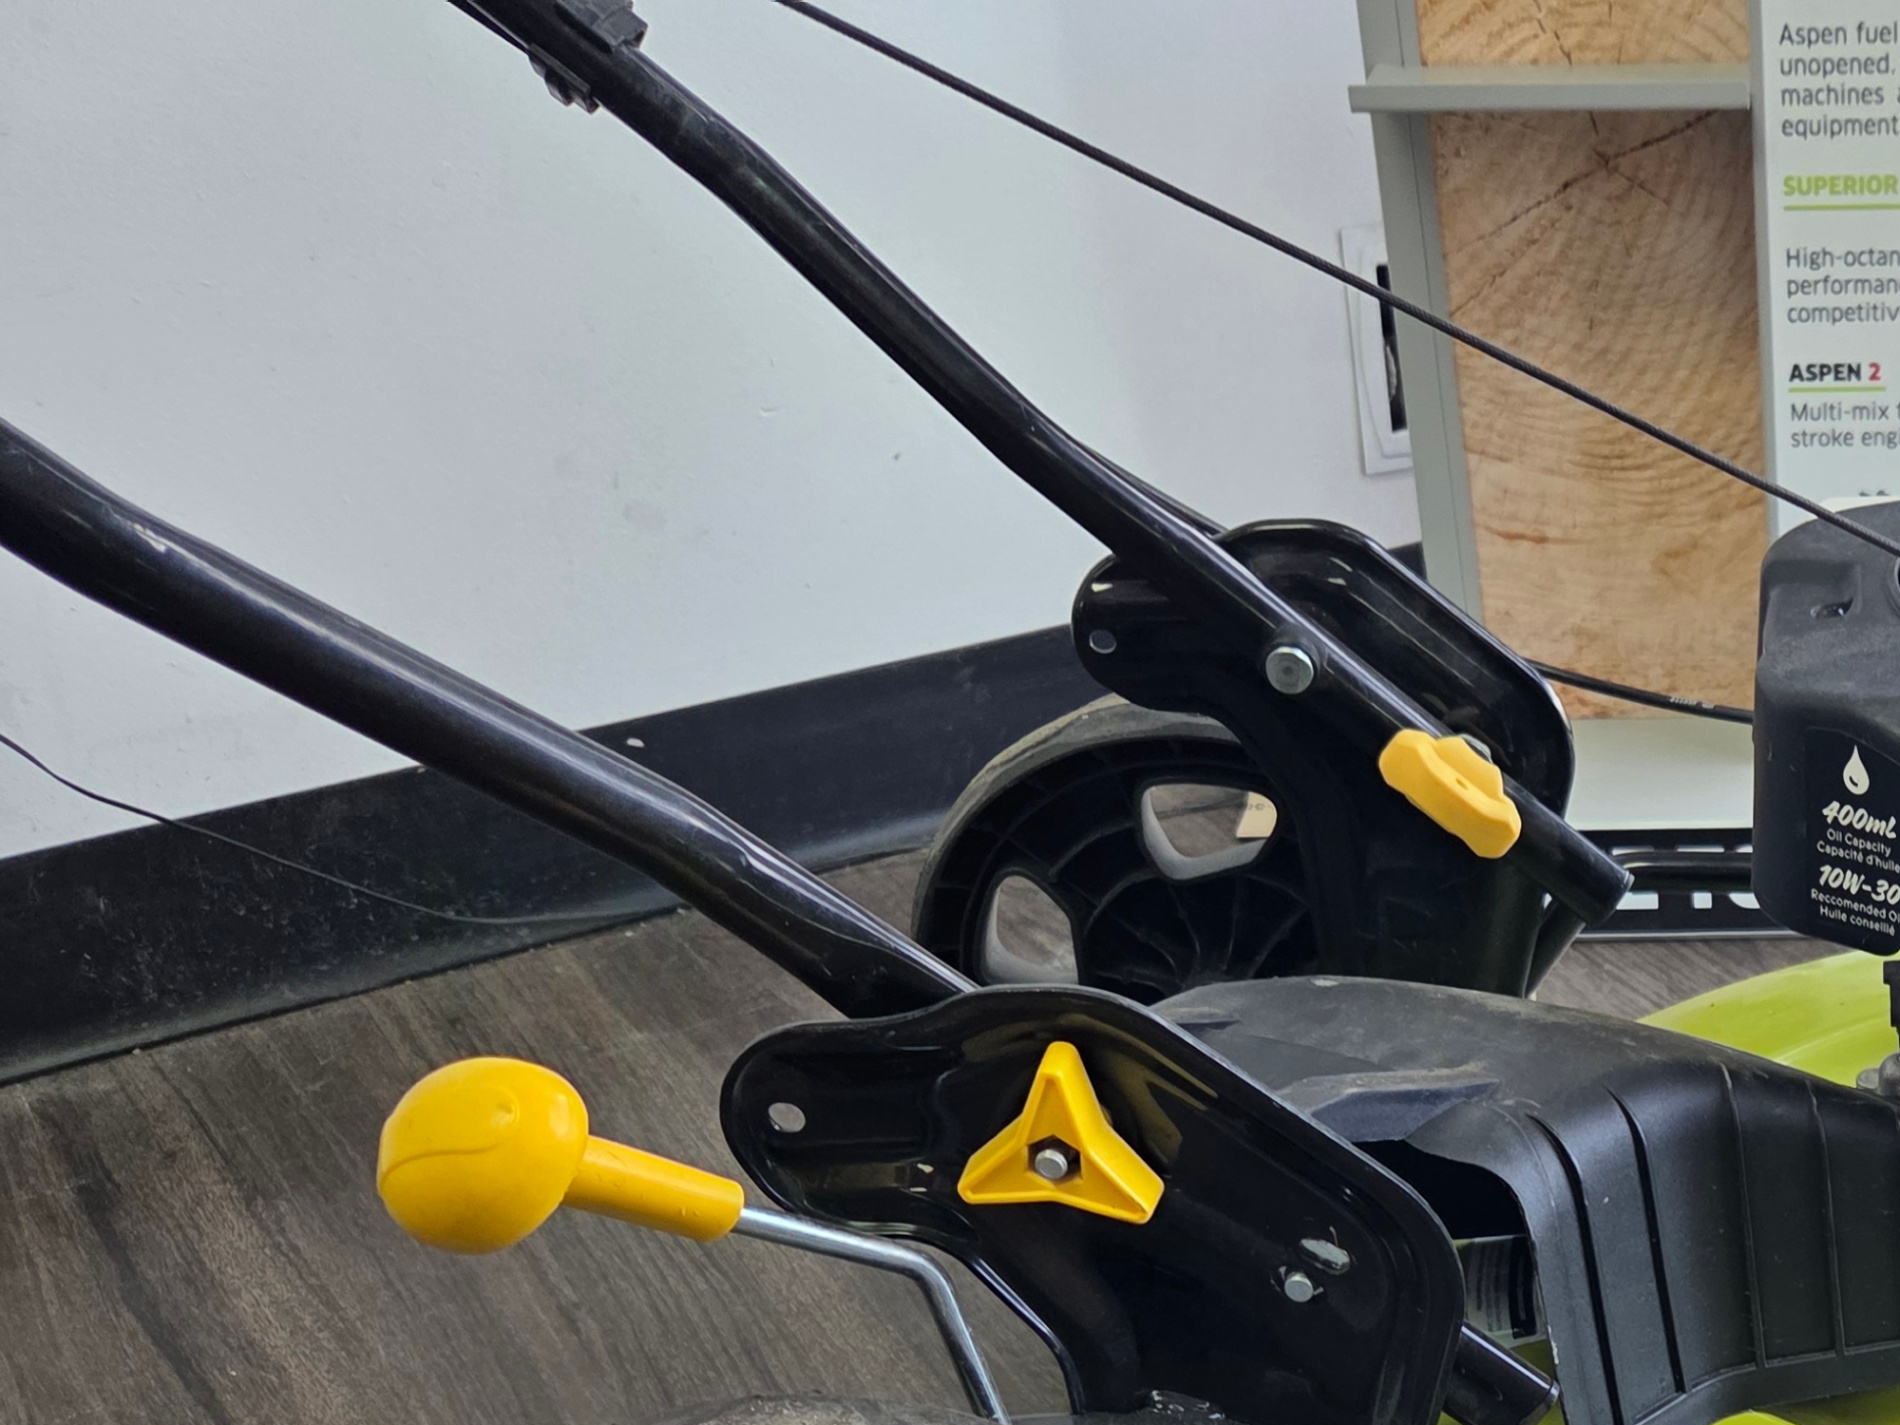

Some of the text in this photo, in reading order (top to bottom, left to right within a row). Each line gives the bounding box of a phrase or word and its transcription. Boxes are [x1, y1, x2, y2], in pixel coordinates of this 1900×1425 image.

[1779, 23, 1847, 49] Aspen
[1857, 21, 1898, 45] fuel
[1780, 53, 1896, 79] unopened.
[1781, 83, 1884, 106] machines
[1781, 114, 1899, 140] equipment
[1783, 174, 1898, 196] SUPERIOR
[1789, 363, 1881, 382] ASPEN 2
[1791, 402, 1889, 422] Multi-mix
[1791, 429, 1854, 448] stroke
[1822, 801, 1897, 838] 400mL
[1827, 828, 1891, 857] Oil Capacity
[1817, 840, 1900, 874] Capacité d'huile
[1811, 888, 1886, 919] Reccomended
[1820, 905, 1895, 936] Huile conseillé
